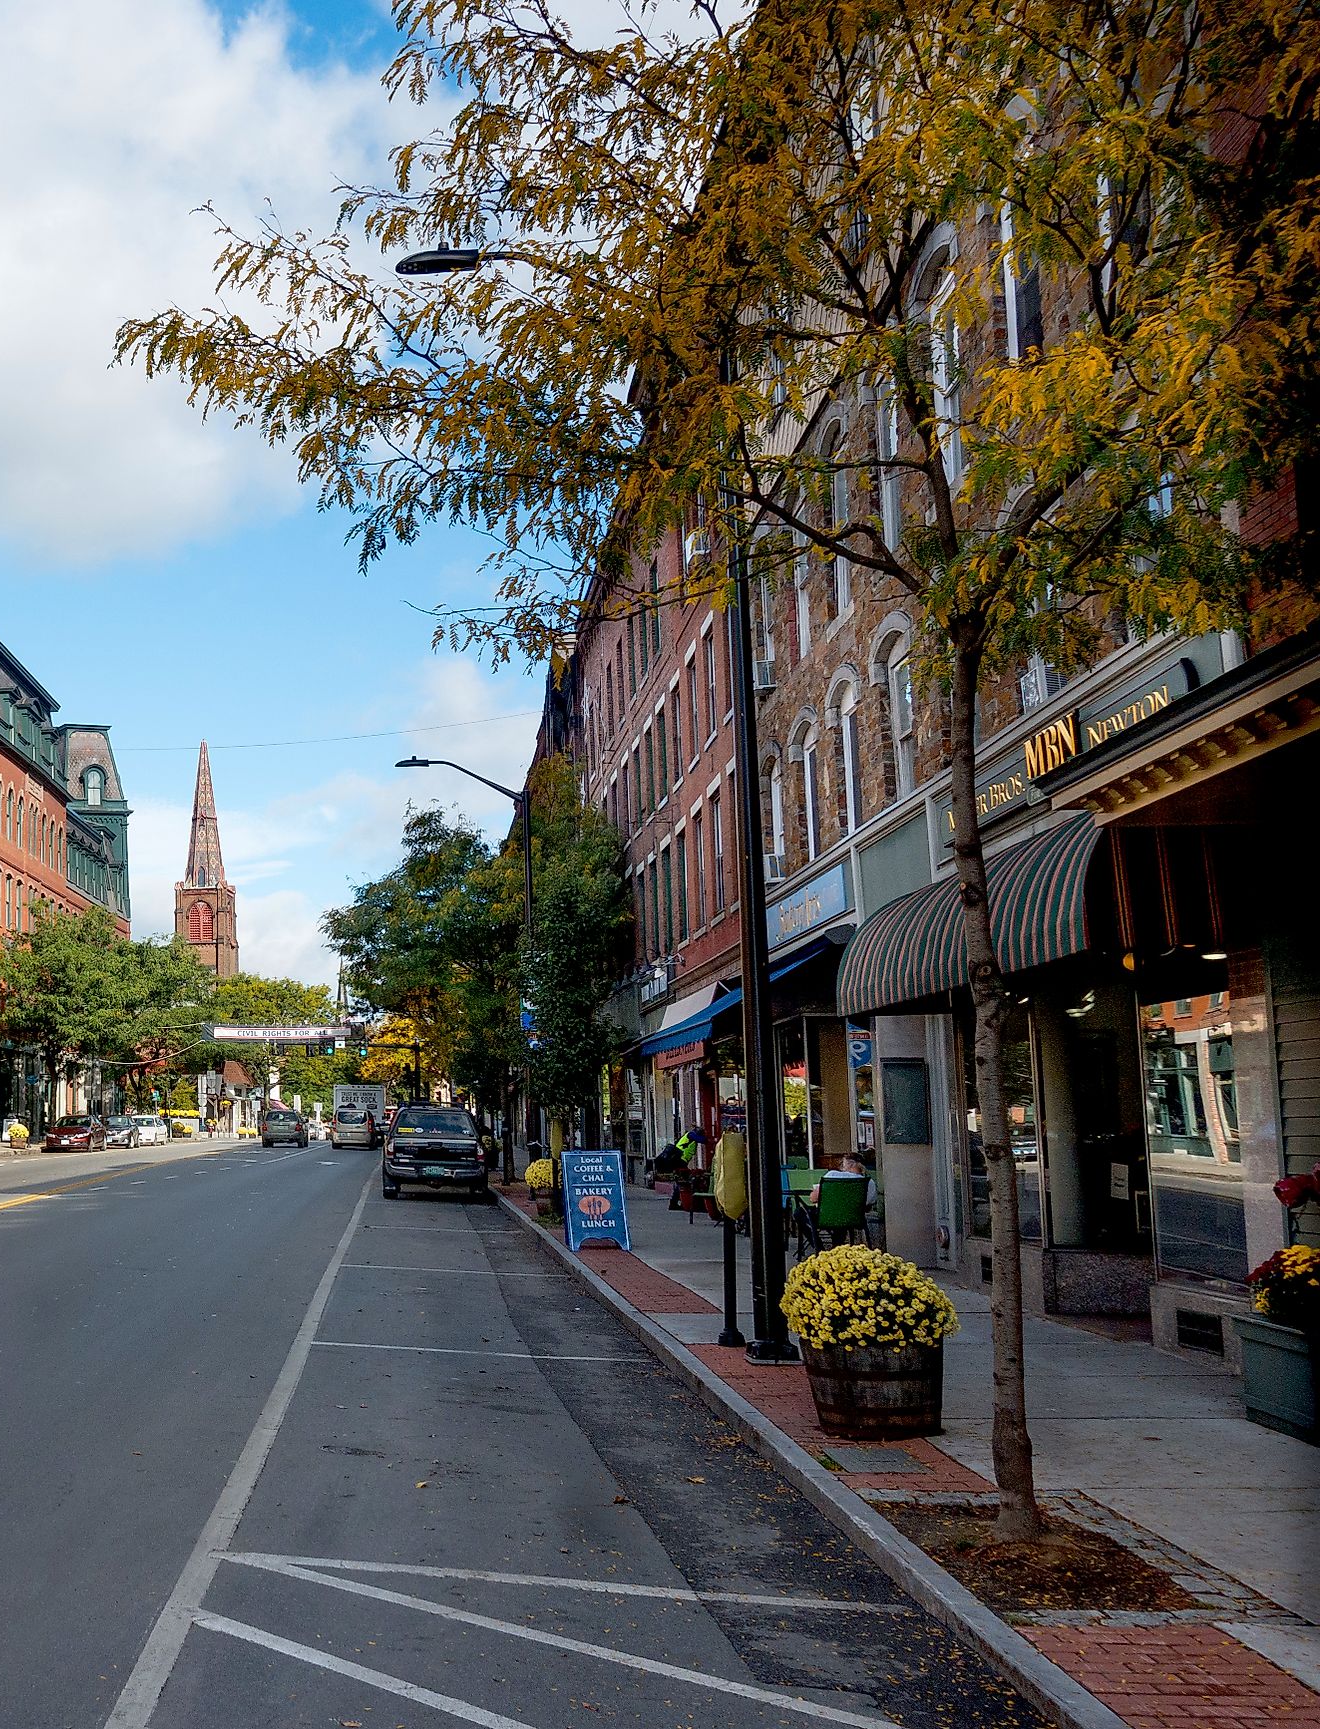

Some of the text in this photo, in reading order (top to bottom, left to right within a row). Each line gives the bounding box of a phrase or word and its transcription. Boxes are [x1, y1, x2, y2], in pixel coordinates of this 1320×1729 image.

[1086, 685, 1169, 749] NEWTON
[1023, 712, 1077, 781] MBN
[988, 771, 1026, 812] BROS.
[237, 1030, 329, 1038] CIVIL RIGHTS FOR ALL
